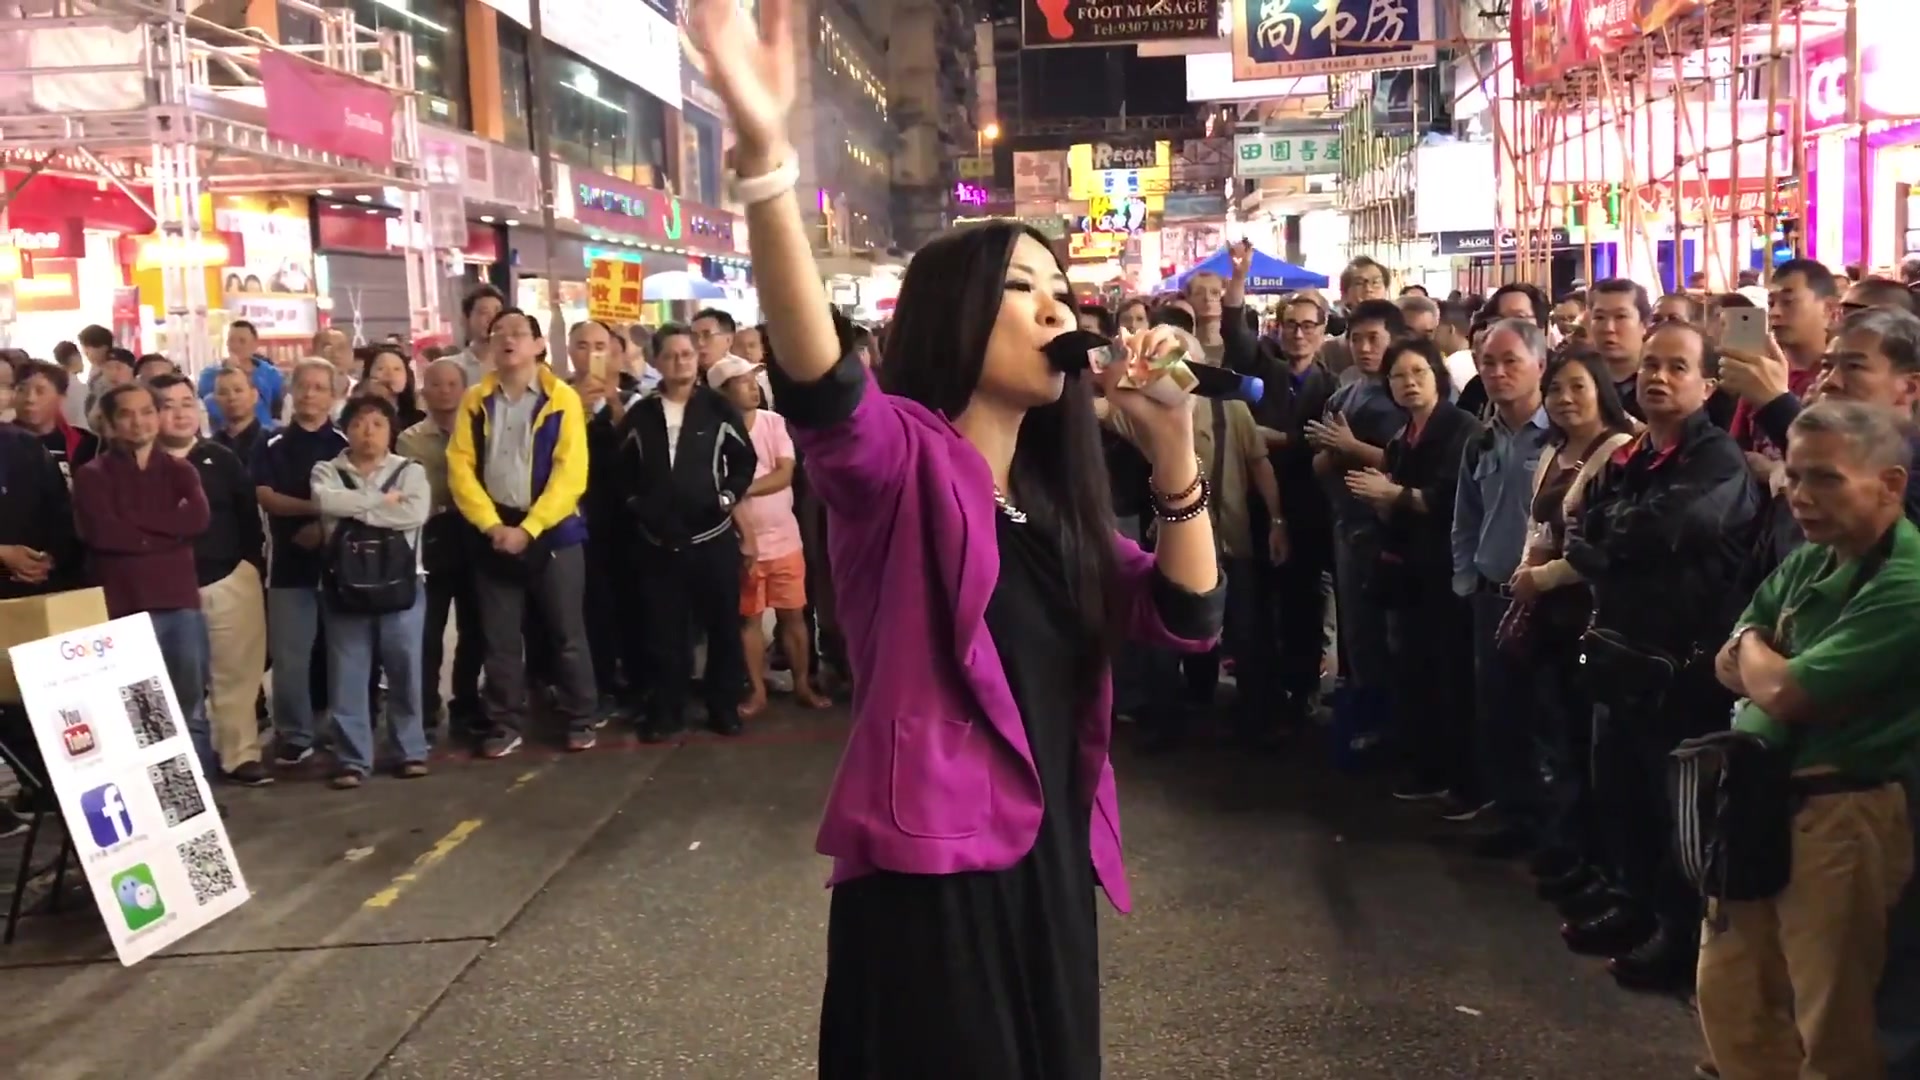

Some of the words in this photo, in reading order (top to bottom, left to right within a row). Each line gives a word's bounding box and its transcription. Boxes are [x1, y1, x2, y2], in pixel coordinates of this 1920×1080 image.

[1078, 5, 1122, 19] FOOT
[1126, 1, 1207, 18] MASSAGE
[1094, 22, 1149, 35] Tel:9307
[1187, 18, 1208, 31] 2/F
[1094, 142, 1154, 169] REGAL
[1458, 238, 1490, 247] SALON
[1253, 276, 1284, 286] Band
[58, 709, 82, 727] You
